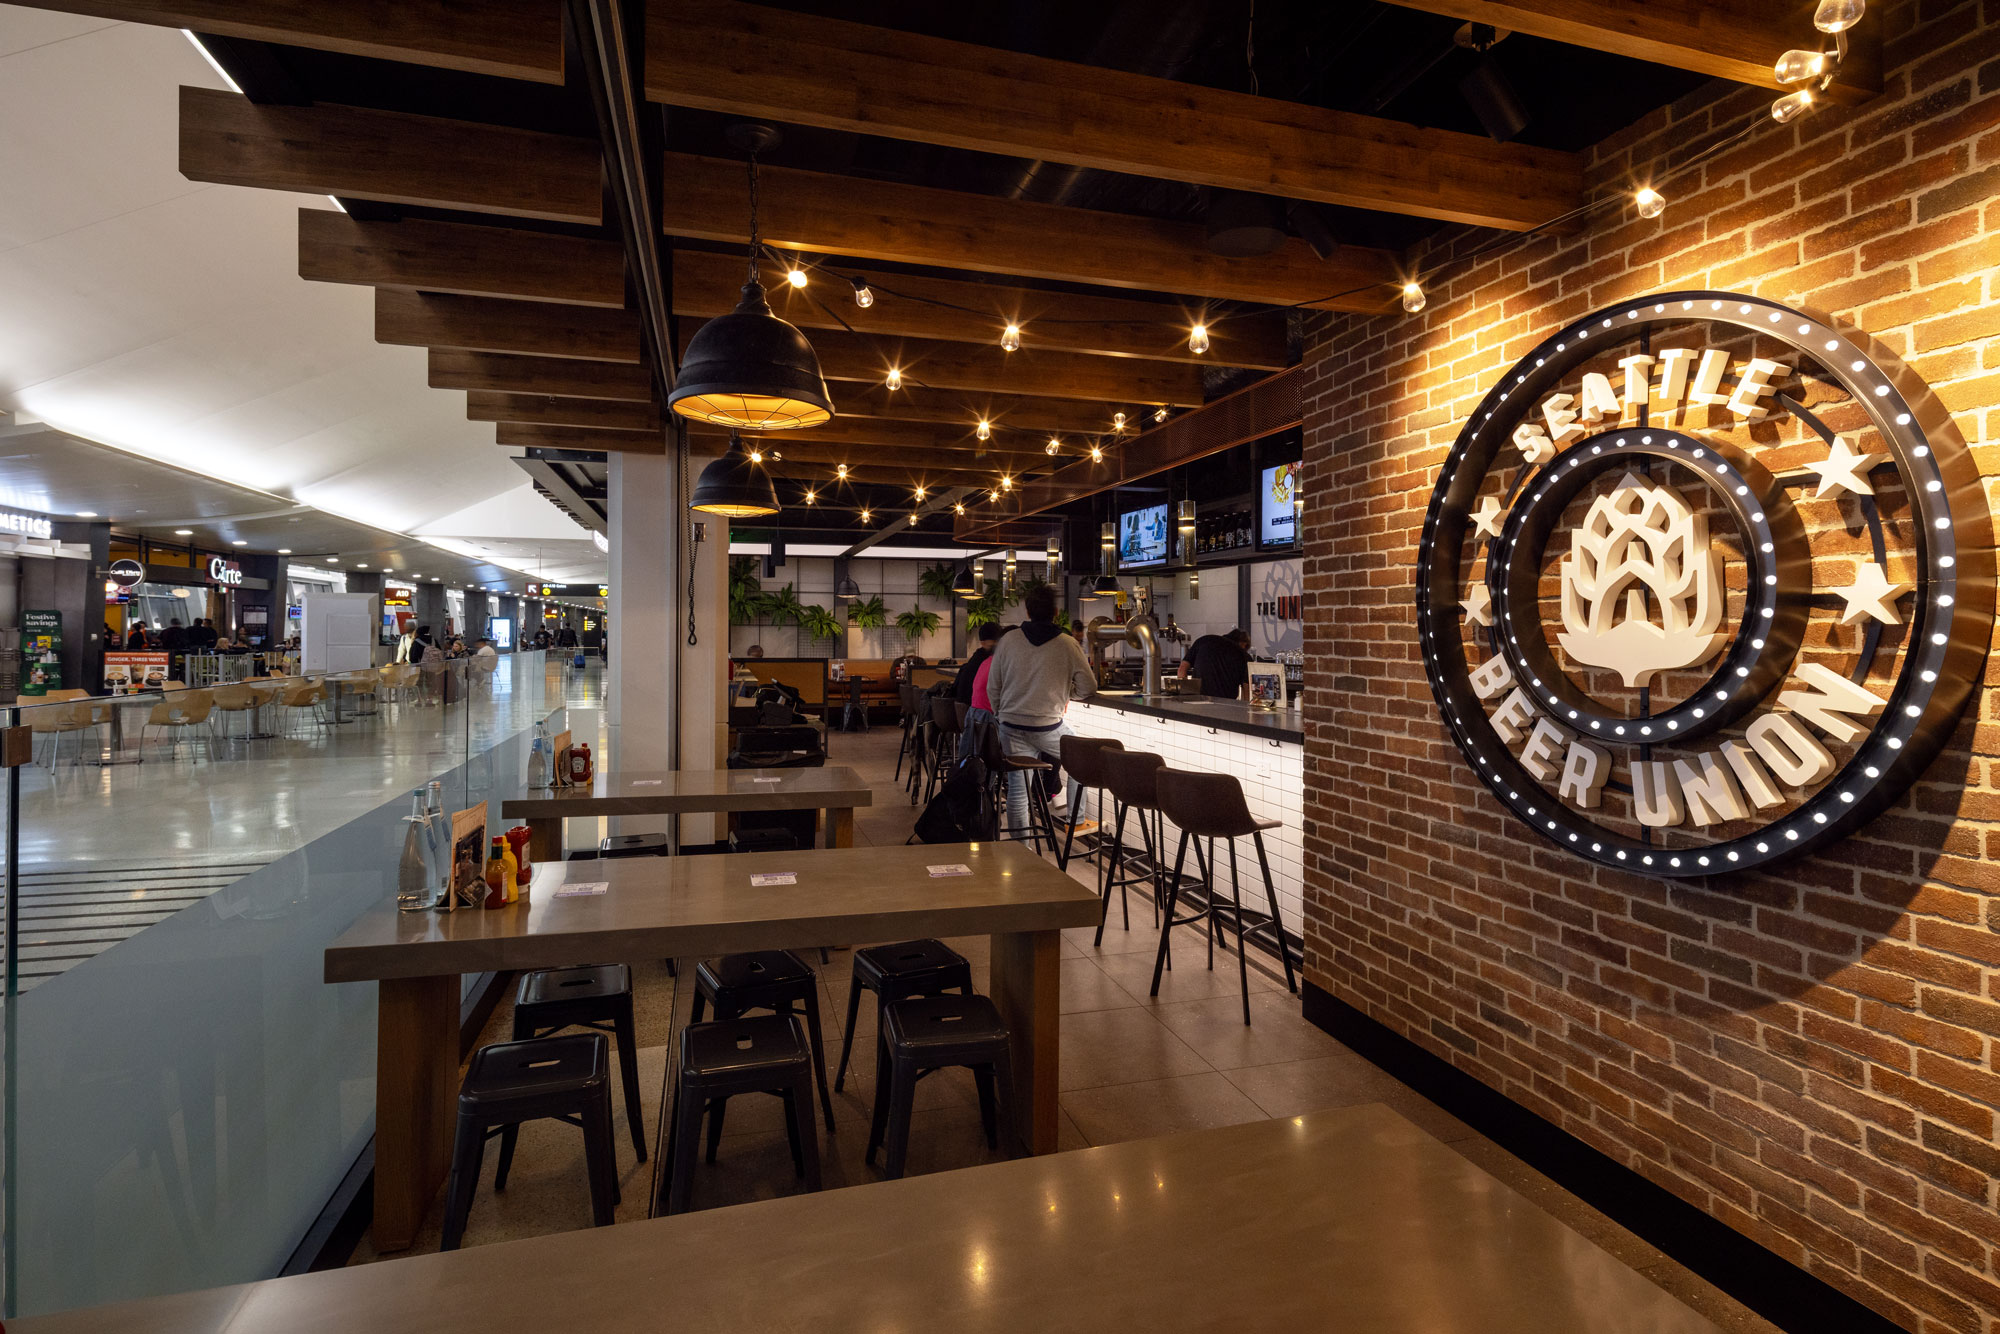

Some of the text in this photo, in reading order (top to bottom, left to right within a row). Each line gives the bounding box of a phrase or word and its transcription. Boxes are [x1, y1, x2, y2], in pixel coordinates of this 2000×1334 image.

[1512, 348, 1793, 463] SEATTLE
[1257, 602, 1275, 616] THE
[1468, 652, 1888, 828] BEER UNION
